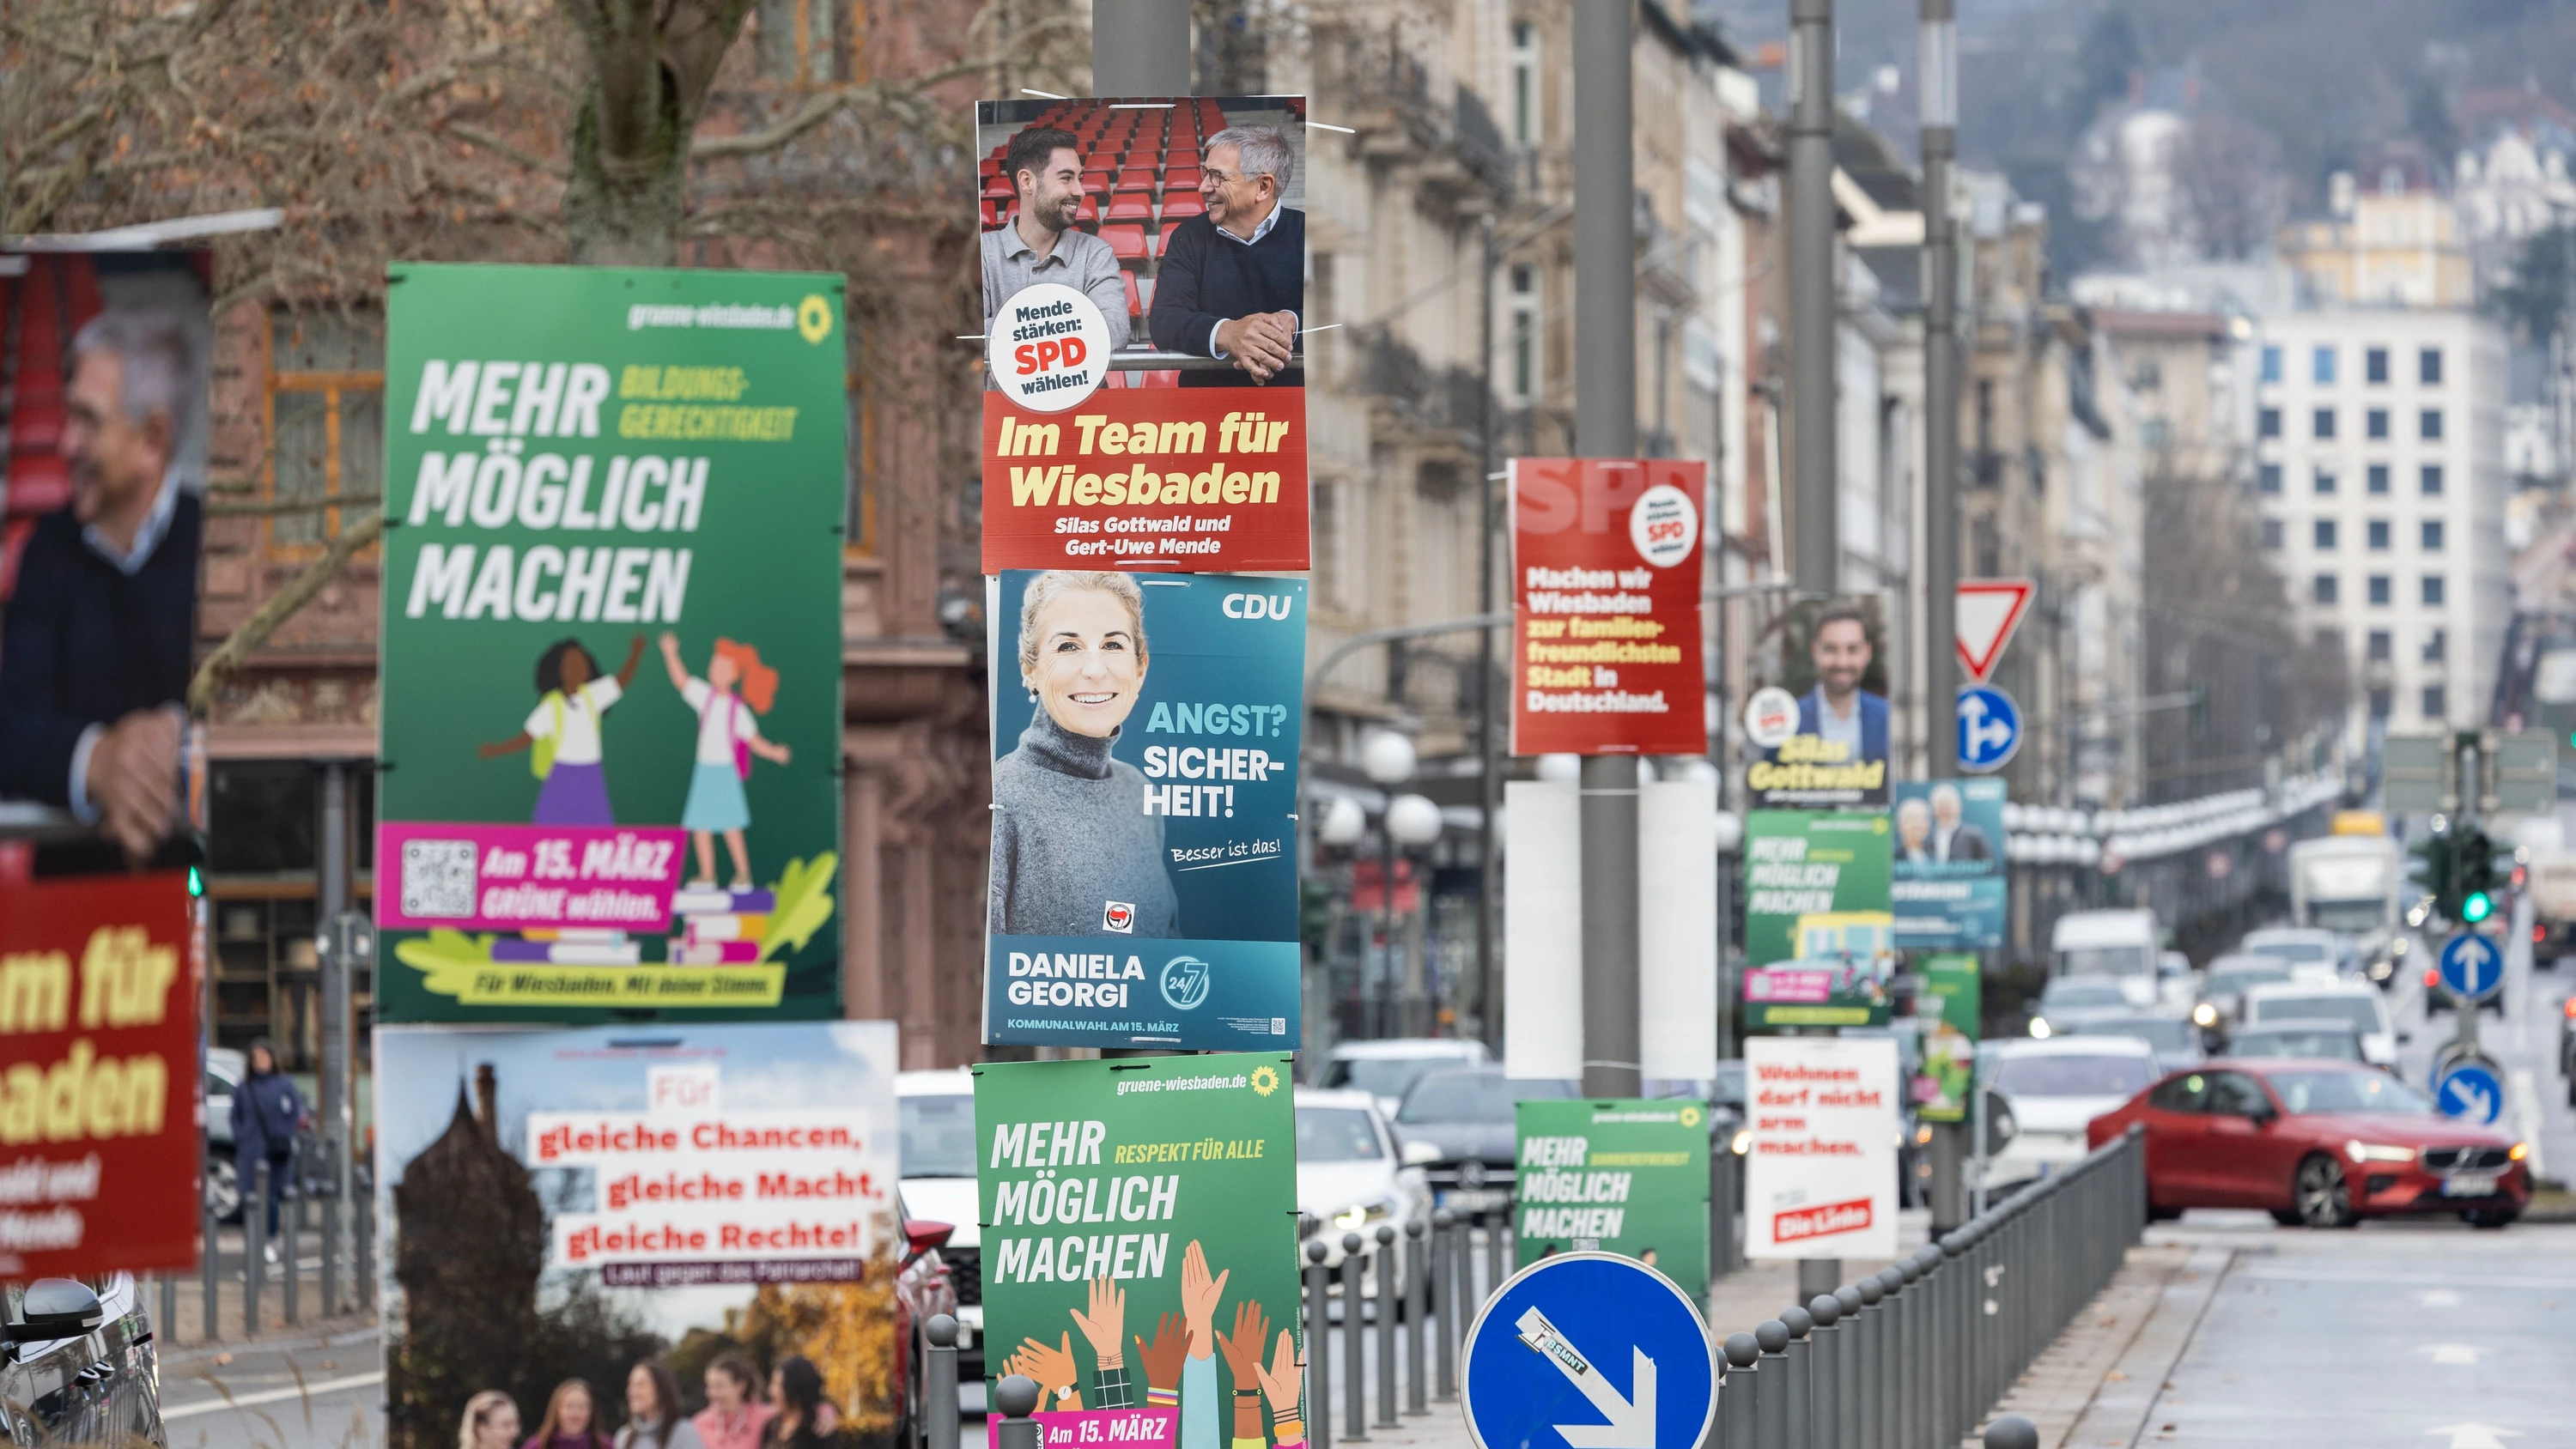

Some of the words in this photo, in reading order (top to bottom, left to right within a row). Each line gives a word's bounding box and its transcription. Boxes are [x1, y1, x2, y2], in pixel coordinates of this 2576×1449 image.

[628, 304, 795, 330] gruene-wiesbaden.de
[1015, 300, 1073, 324] Mende
[1012, 318, 1083, 342] stärken:
[1015, 336, 1087, 375] SPD
[410, 360, 611, 438] MEHR
[618, 365, 750, 400] BILDUNGS-
[1021, 370, 1090, 395] wählen!
[618, 405, 799, 440] GERECHTIGKEIT
[997, 416, 1060, 457] Im
[1074, 415, 1206, 455] Team
[1218, 411, 1290, 454] für
[407, 436, 711, 532] MÖGLICH
[1010, 463, 1281, 507] Wiesbaden
[1054, 517, 1100, 534] Silas
[1104, 515, 1191, 533] Gottwald
[1194, 514, 1231, 531] und
[1649, 521, 1685, 543] SPD
[1066, 539, 1156, 555] Gert-Uwe
[1159, 537, 1221, 554] Mende
[405, 543, 693, 624] MACHEN
[1527, 566, 1616, 589] Machen
[1618, 566, 1653, 589] wir
[1222, 593, 1291, 621] CDU
[1527, 591, 1652, 614] Wiesbaden
[1527, 619, 1567, 638] zur
[1569, 615, 1665, 639] familien-
[1527, 641, 1680, 664] freundlichsten
[1527, 666, 1592, 688] Stadt
[1594, 664, 1618, 688] in
[1527, 690, 1669, 713] Deutschland.
[1145, 702, 1287, 737] ANGST?
[1143, 745, 1285, 781] SICHER-
[1748, 760, 1885, 791] Gottwald
[1143, 785, 1234, 818] HEIT!
[481, 846, 527, 879] Am
[532, 838, 576, 880] 15.
[580, 834, 675, 881] MÄRZ
[1170, 845, 1225, 863] Besser
[1228, 840, 1249, 856] ist
[1253, 839, 1282, 854] das!
[1750, 837, 1807, 860] MEHR
[481, 882, 566, 920] GRÜNE
[566, 890, 661, 921] wählen.
[79, 924, 178, 1029] für
[1010, 952, 1145, 981] DANIELA
[1169, 962, 1208, 1003] 24/7
[1008, 981, 1128, 1009] GEORGI
[1007, 1019, 1109, 1031] KOMMUNALWAHL
[1110, 1022, 1129, 1032] AM
[1131, 1022, 1145, 1032] 15.
[1147, 1021, 1179, 1033] MÄRZ
[1117, 1075, 1247, 1095] gruene-wiesbaden.de
[1757, 1064, 1859, 1082] Wohnen
[0, 1037, 168, 1145] aden
[654, 1073, 716, 1107] Für
[1758, 1088, 1809, 1106] darf
[538, 1123, 678, 1160] gleiche
[692, 1123, 863, 1153] Chancen,
[990, 1120, 1106, 1169] MEHR
[1115, 1142, 1190, 1164] RESPEKT
[1193, 1137, 1224, 1161] FÜR
[1226, 1138, 1265, 1160] ALLE
[1522, 1136, 1588, 1167] MEHR
[607, 1173, 744, 1211] gleiche
[758, 1170, 885, 1202] Macht,
[993, 1169, 1180, 1227] MÖGLICH
[1522, 1166, 1631, 1203] MÖGLICH
[1522, 1207, 1625, 1240] MACHEN
[567, 1223, 708, 1261] gleiche
[720, 1221, 860, 1251] Rechte!
[993, 1233, 1170, 1284] MACHEN
[1546, 1337, 1585, 1372] BSMNT
[1048, 1426, 1072, 1444] Am
[1078, 1420, 1104, 1443] 15.
[1109, 1413, 1168, 1442] MÄRZ
